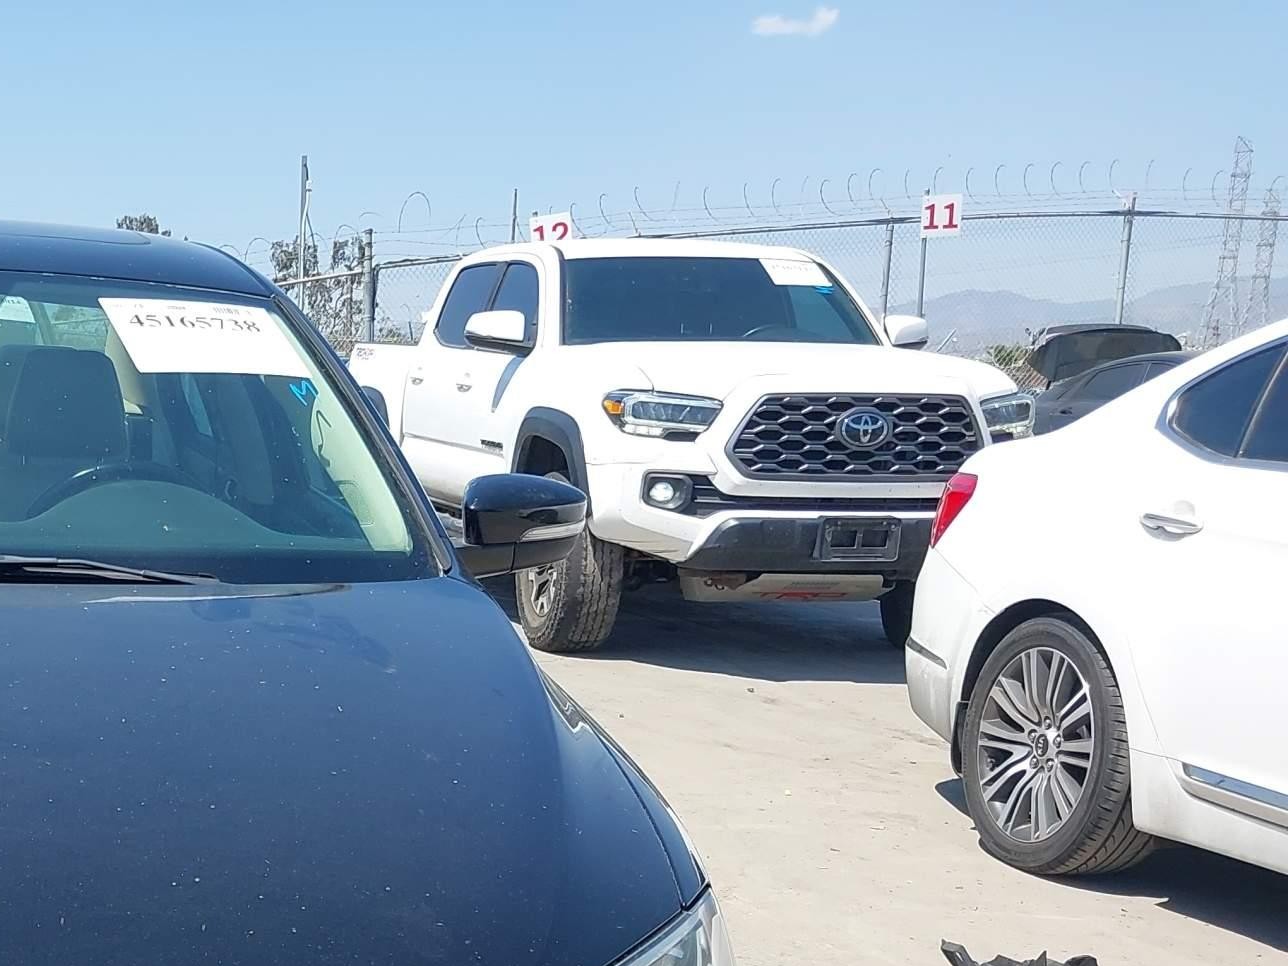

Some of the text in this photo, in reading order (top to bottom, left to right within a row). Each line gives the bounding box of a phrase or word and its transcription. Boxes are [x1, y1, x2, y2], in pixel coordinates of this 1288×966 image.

[923, 203, 958, 230] 11
[533, 222, 569, 241] 12
[129, 313, 261, 332] 45165738
